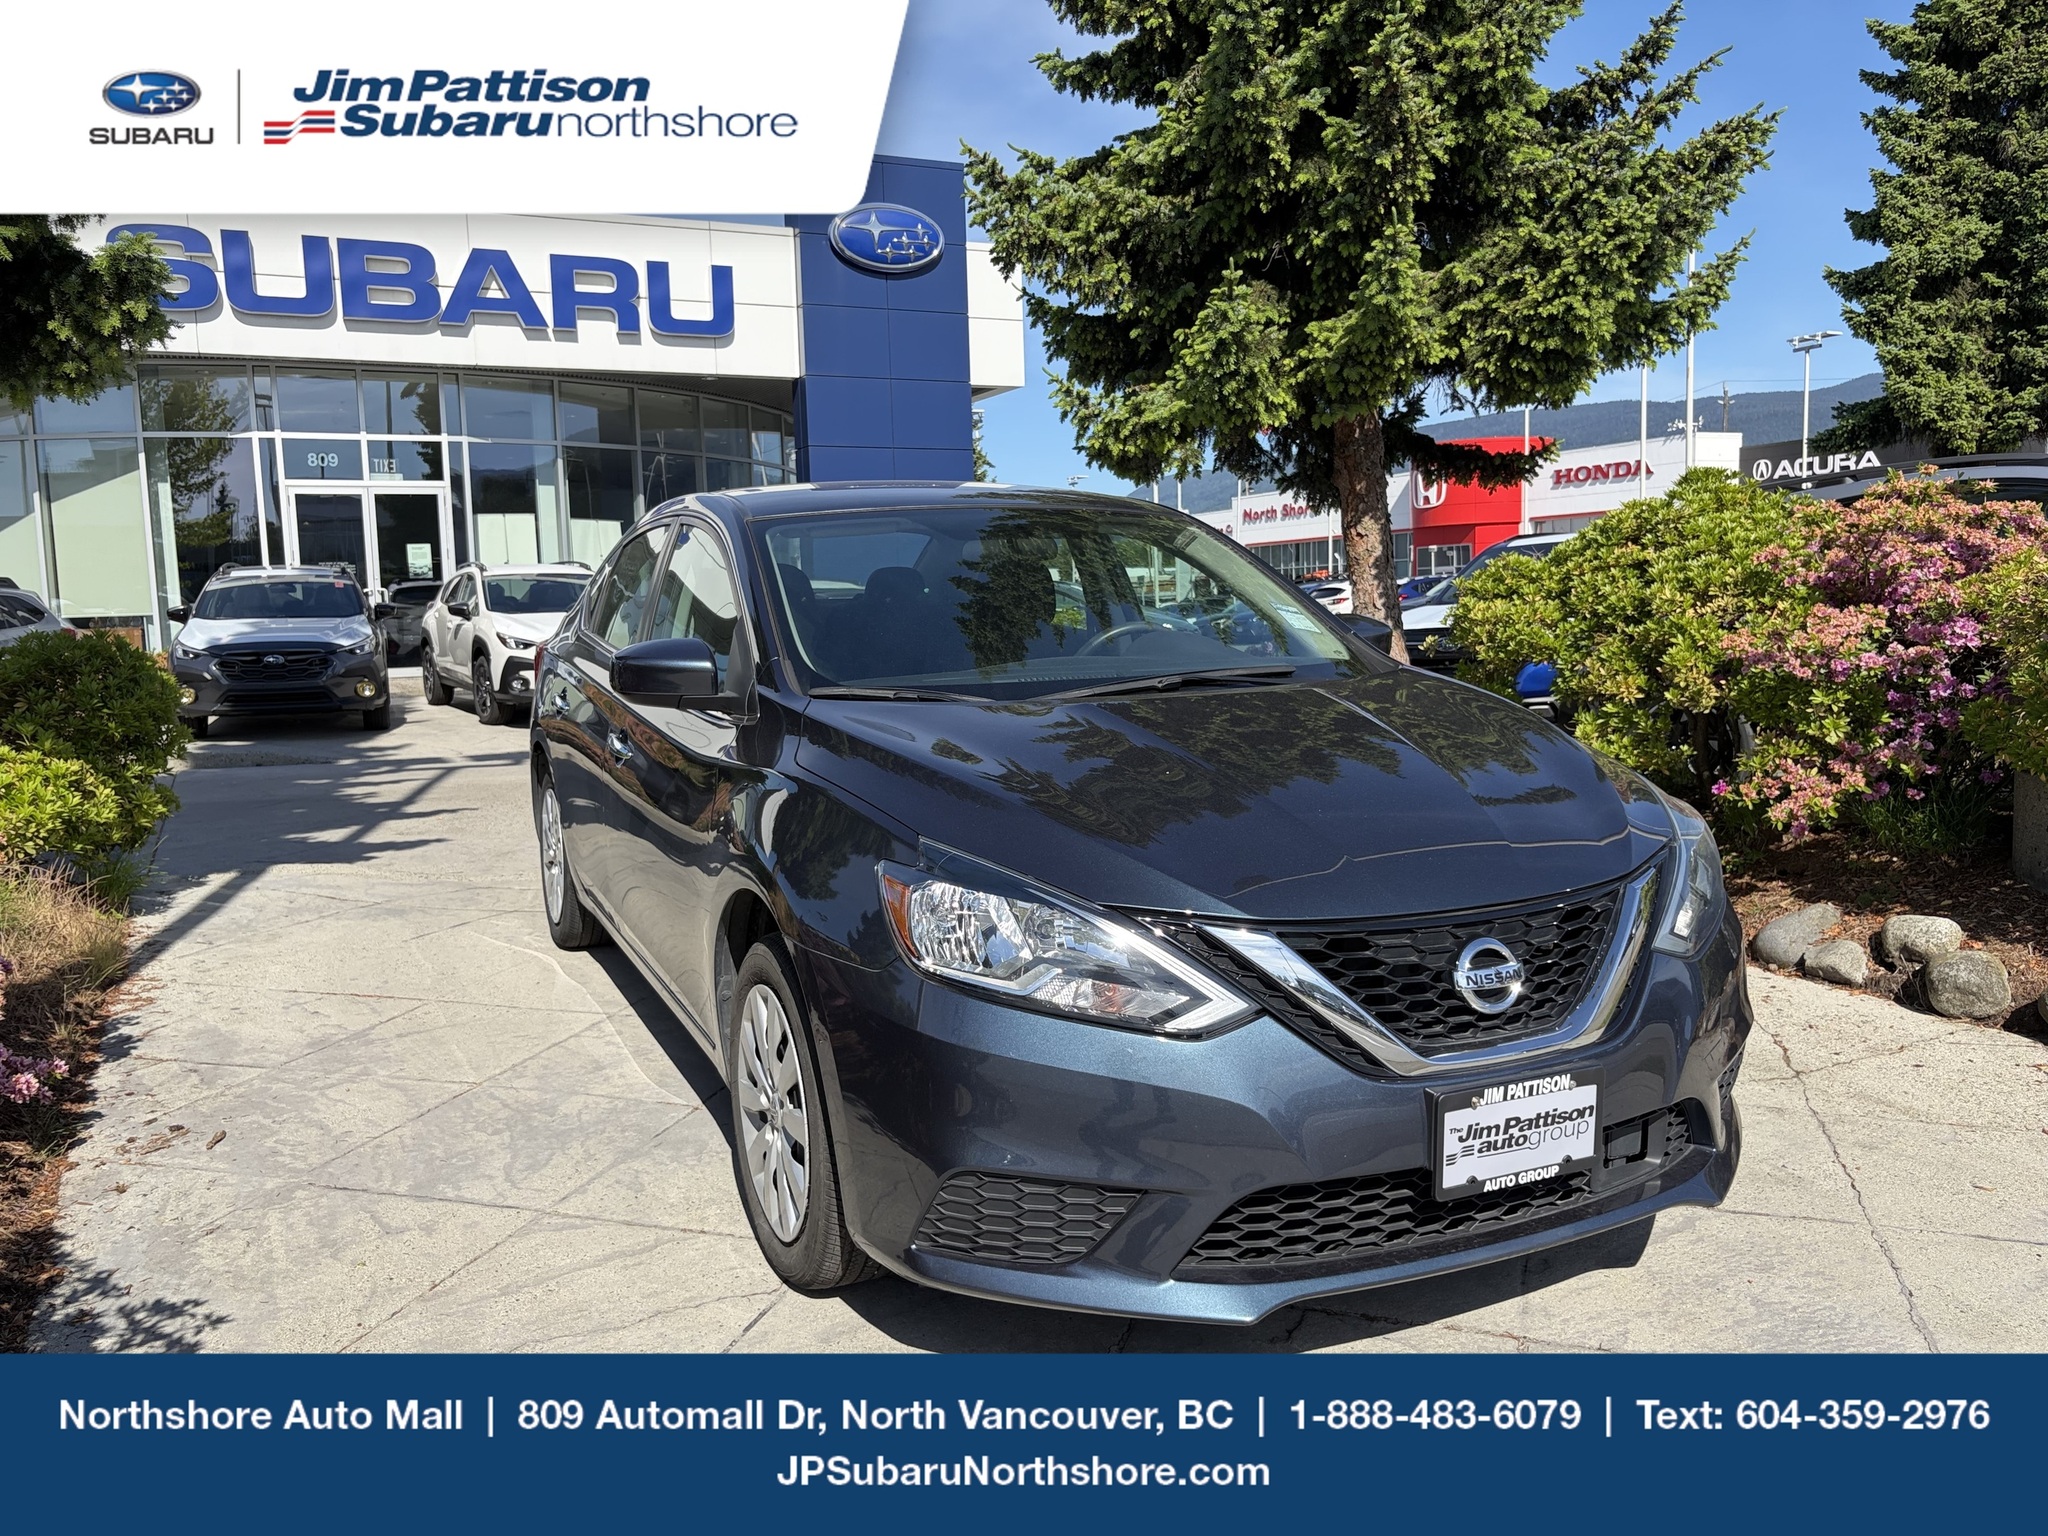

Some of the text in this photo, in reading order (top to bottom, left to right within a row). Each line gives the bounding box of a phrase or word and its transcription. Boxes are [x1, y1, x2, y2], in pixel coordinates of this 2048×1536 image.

[105, 223, 735, 338] SUBARU
[307, 453, 339, 467] 809
[1553, 459, 1654, 485] HONDA
[1773, 450, 1881, 479] ACURA
[1243, 503, 1311, 521] North Shor
[1465, 966, 1523, 986] NISSAN
[1480, 1073, 1571, 1106] JIM PATTISON
[1449, 1104, 1595, 1143] The Jim Pattison
[1484, 1165, 1559, 1192] AUTO GROUP
